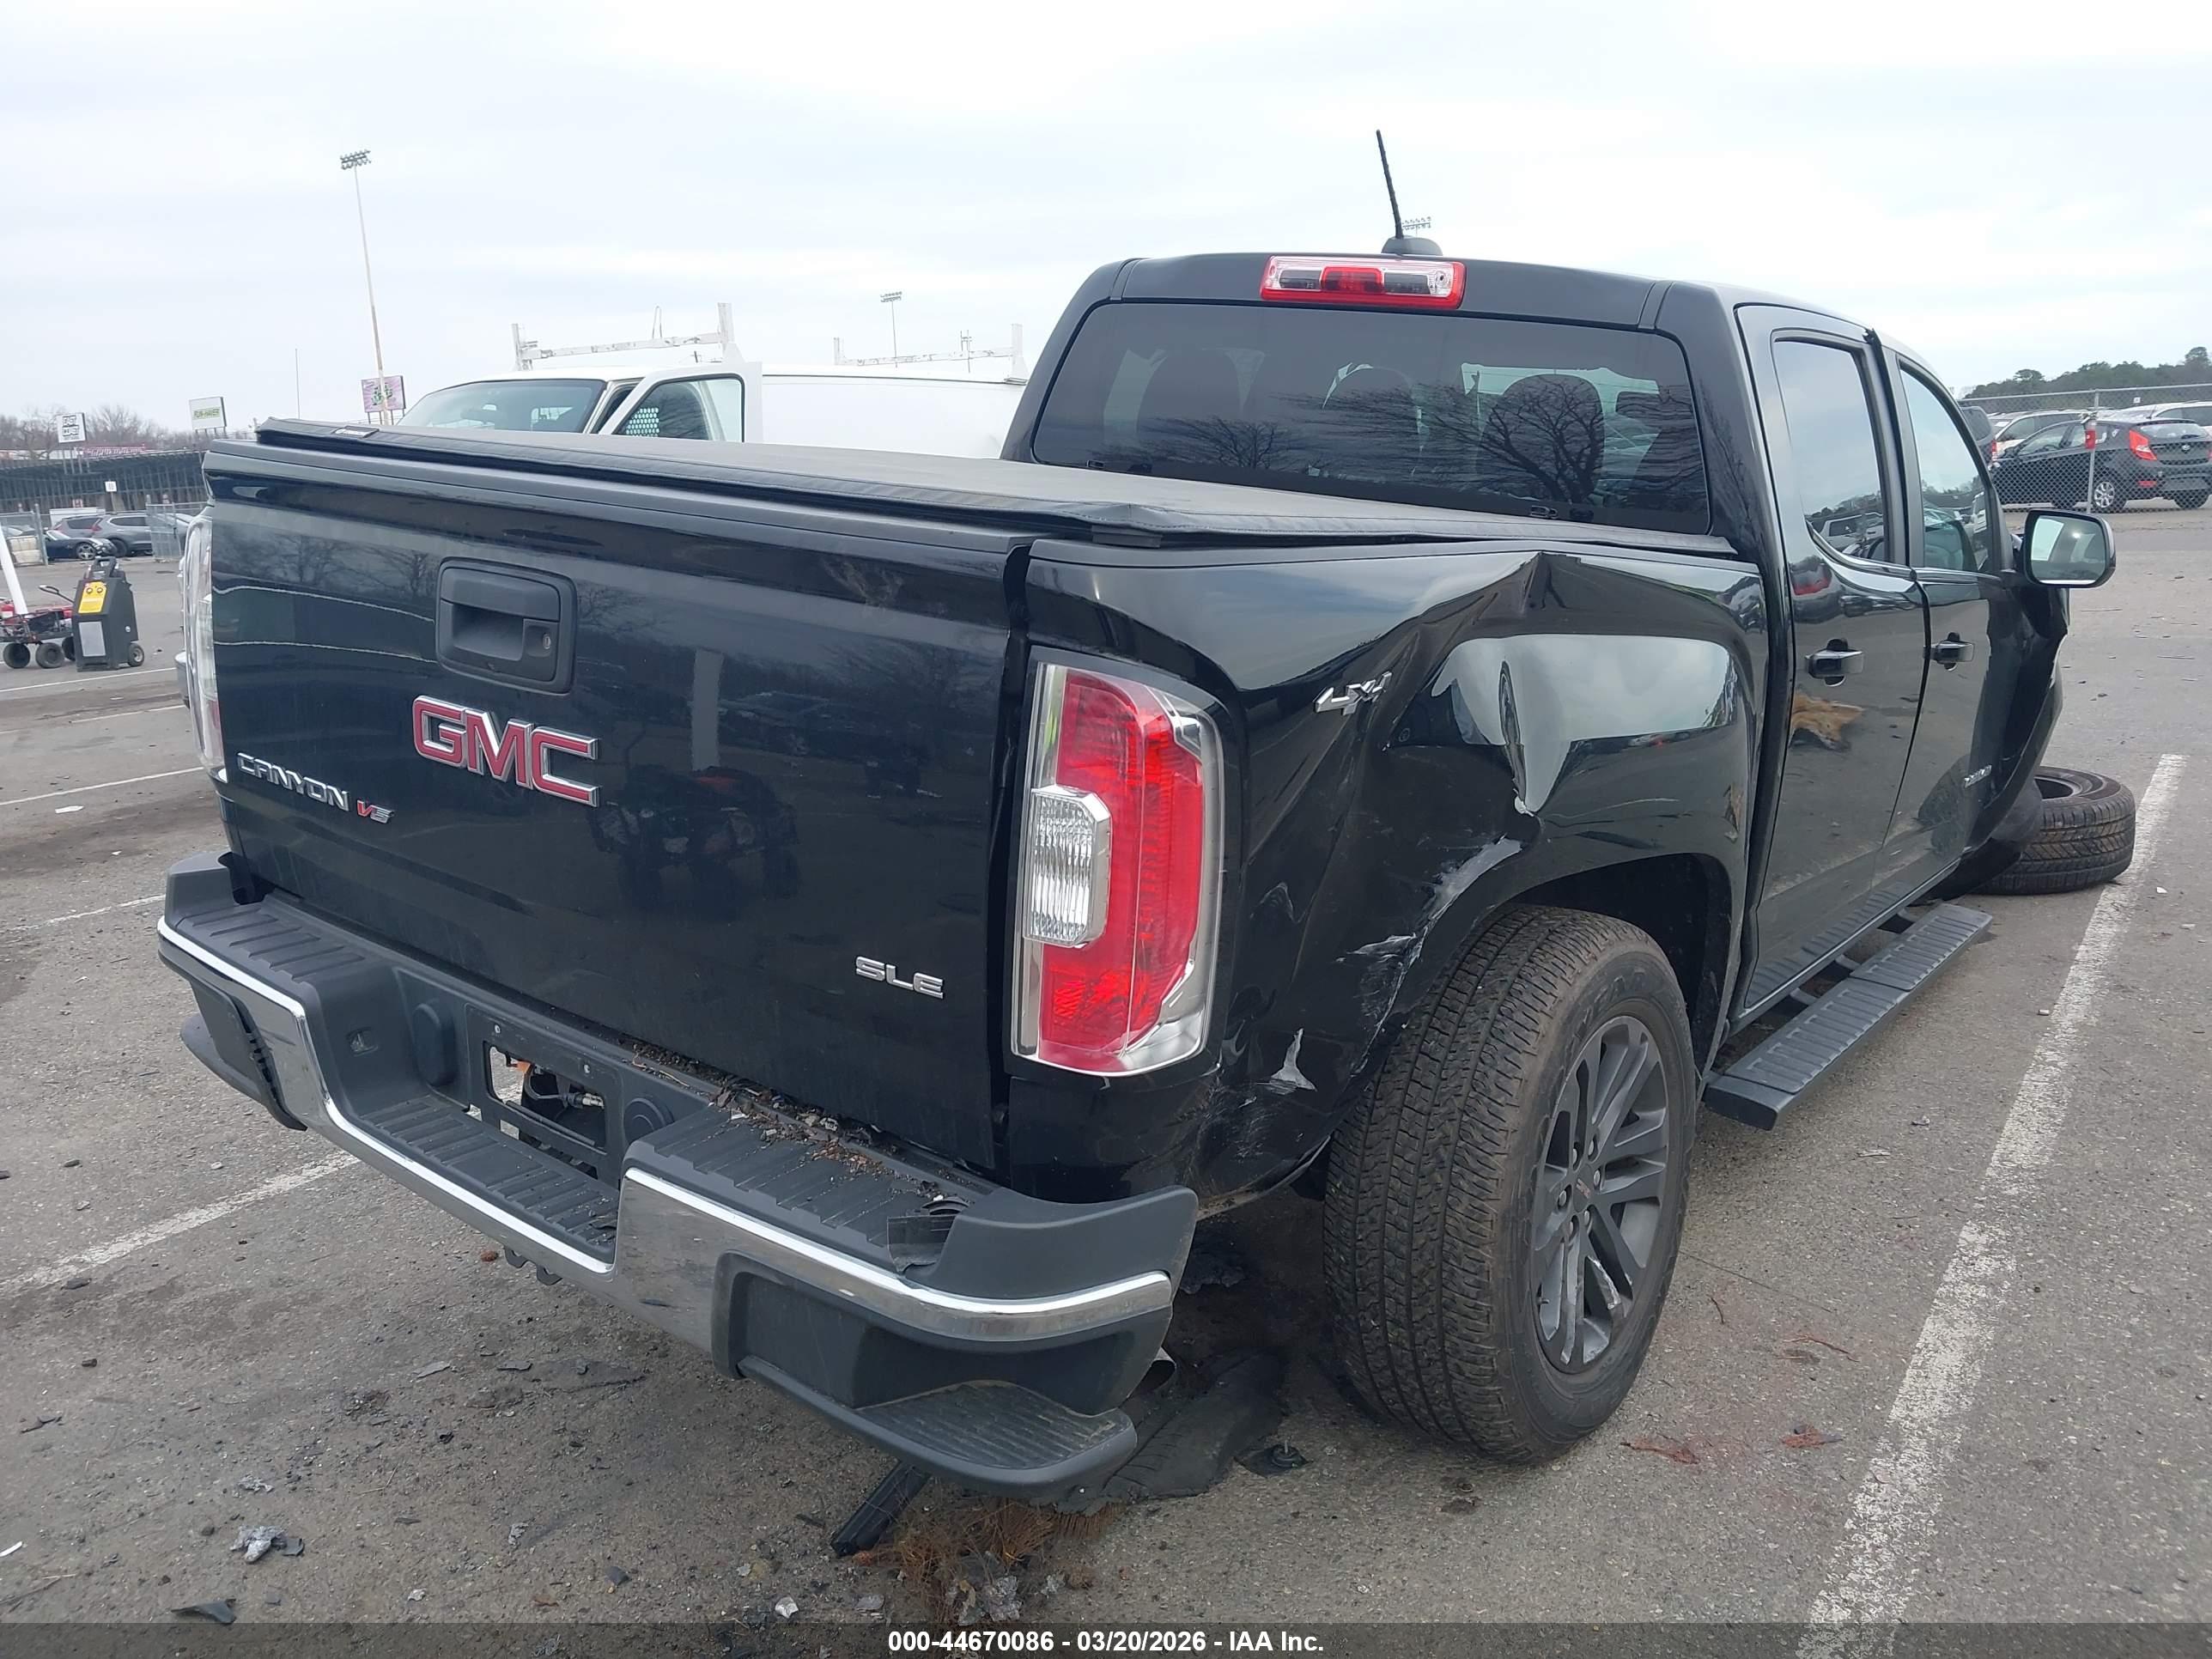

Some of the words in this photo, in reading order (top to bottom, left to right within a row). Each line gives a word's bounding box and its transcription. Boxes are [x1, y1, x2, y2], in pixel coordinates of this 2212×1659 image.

[413, 695, 599, 808] GMC
[236, 752, 350, 811] CANYON
[356, 799, 395, 824] V6
[855, 956, 944, 1000] SLE
